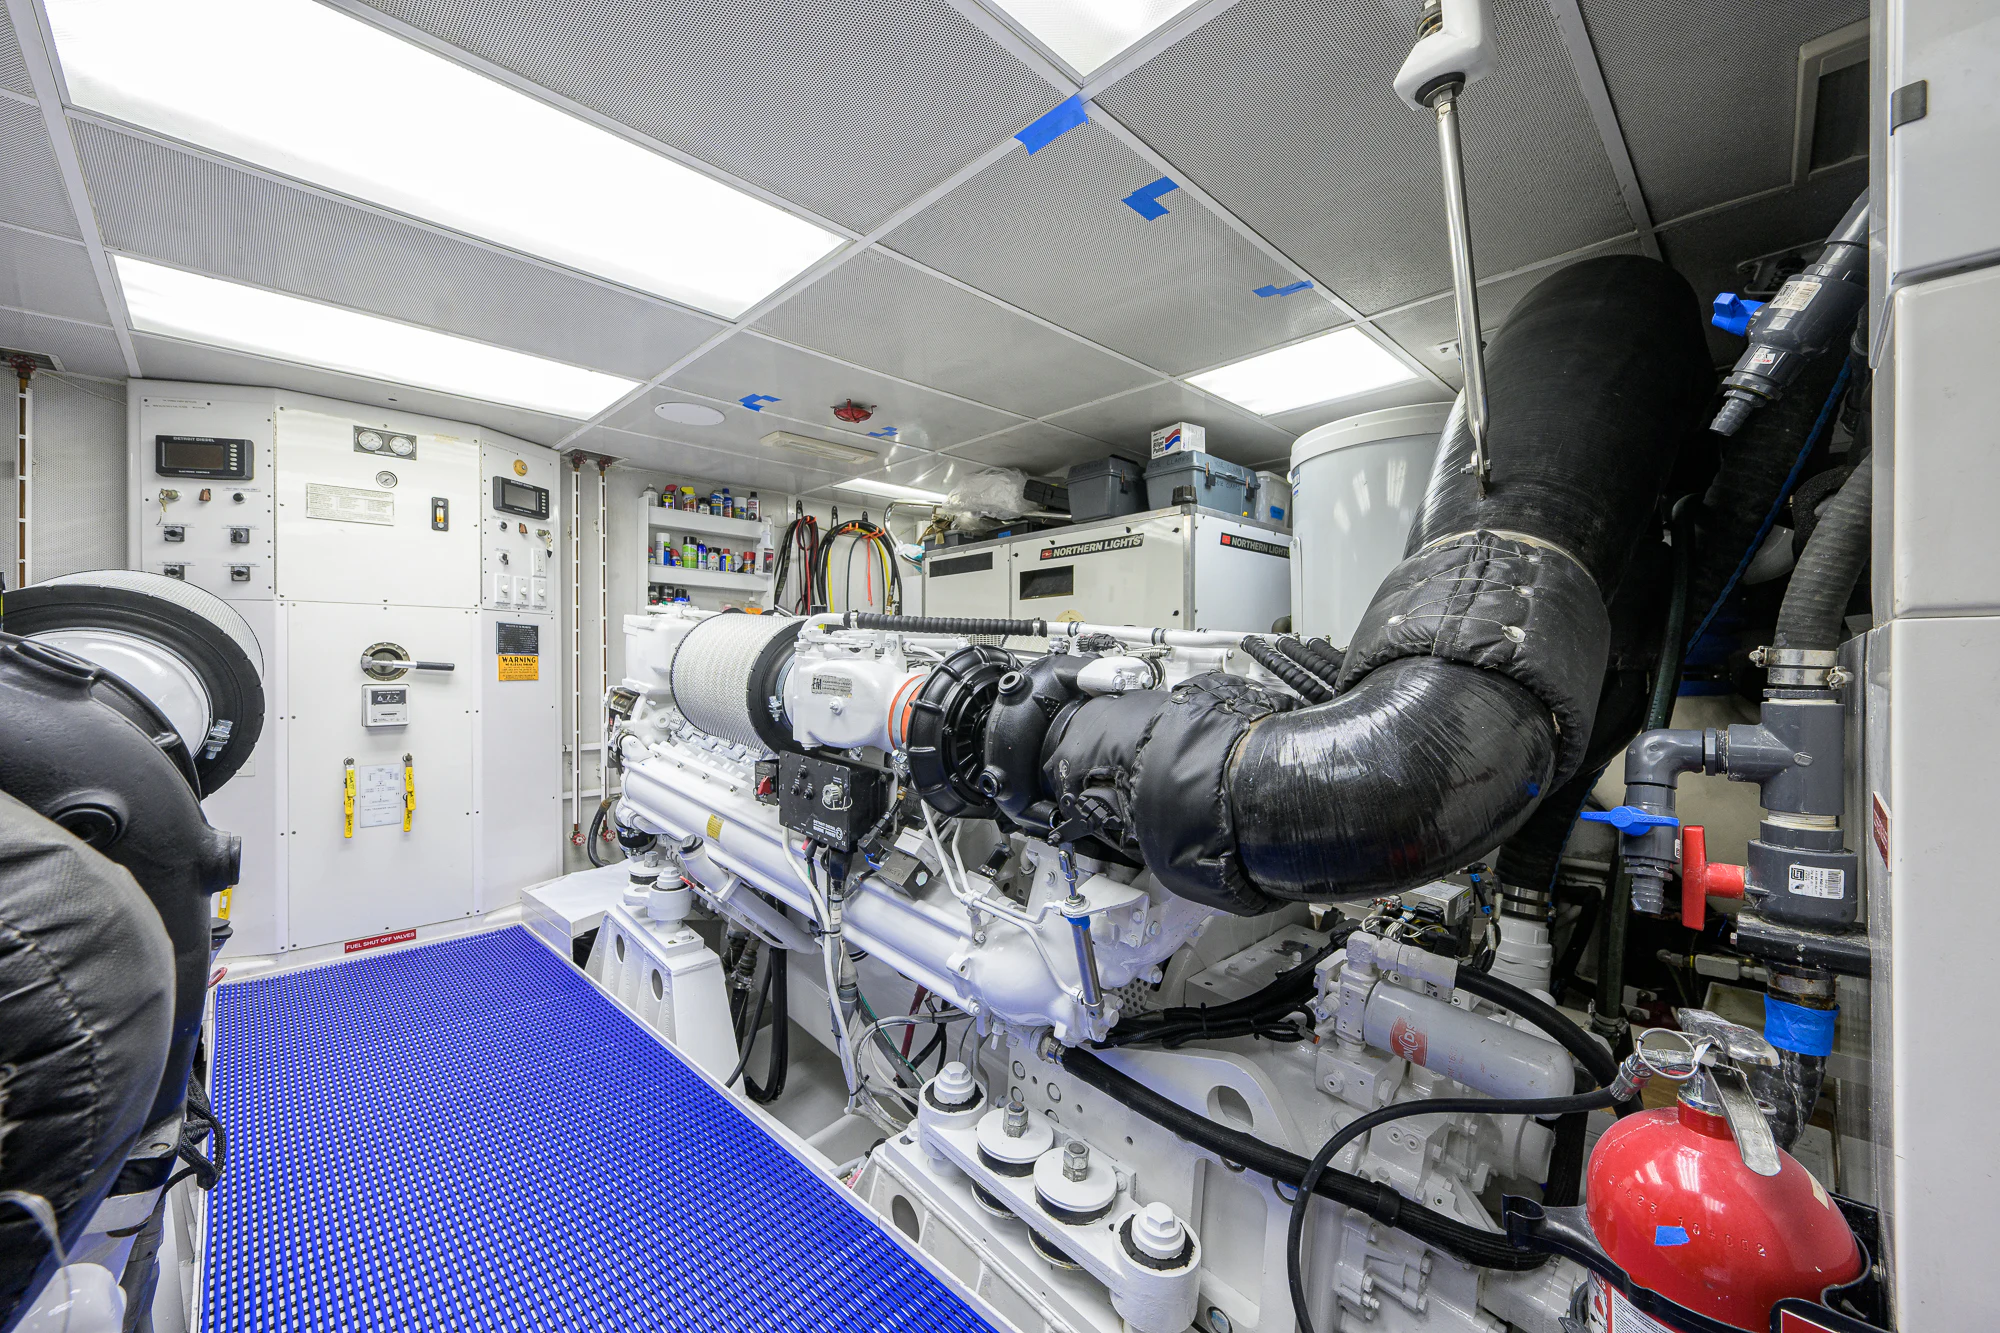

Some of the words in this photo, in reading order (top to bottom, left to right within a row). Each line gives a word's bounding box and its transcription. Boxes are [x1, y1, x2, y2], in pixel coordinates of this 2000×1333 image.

[1053, 541, 1103, 557] NORTHERN
[1104, 535, 1141, 550] LIGHTS
[1231, 536, 1268, 553] NORTHERN
[363, 939, 379, 947] SHUT
[393, 931, 415, 940] VALVES
